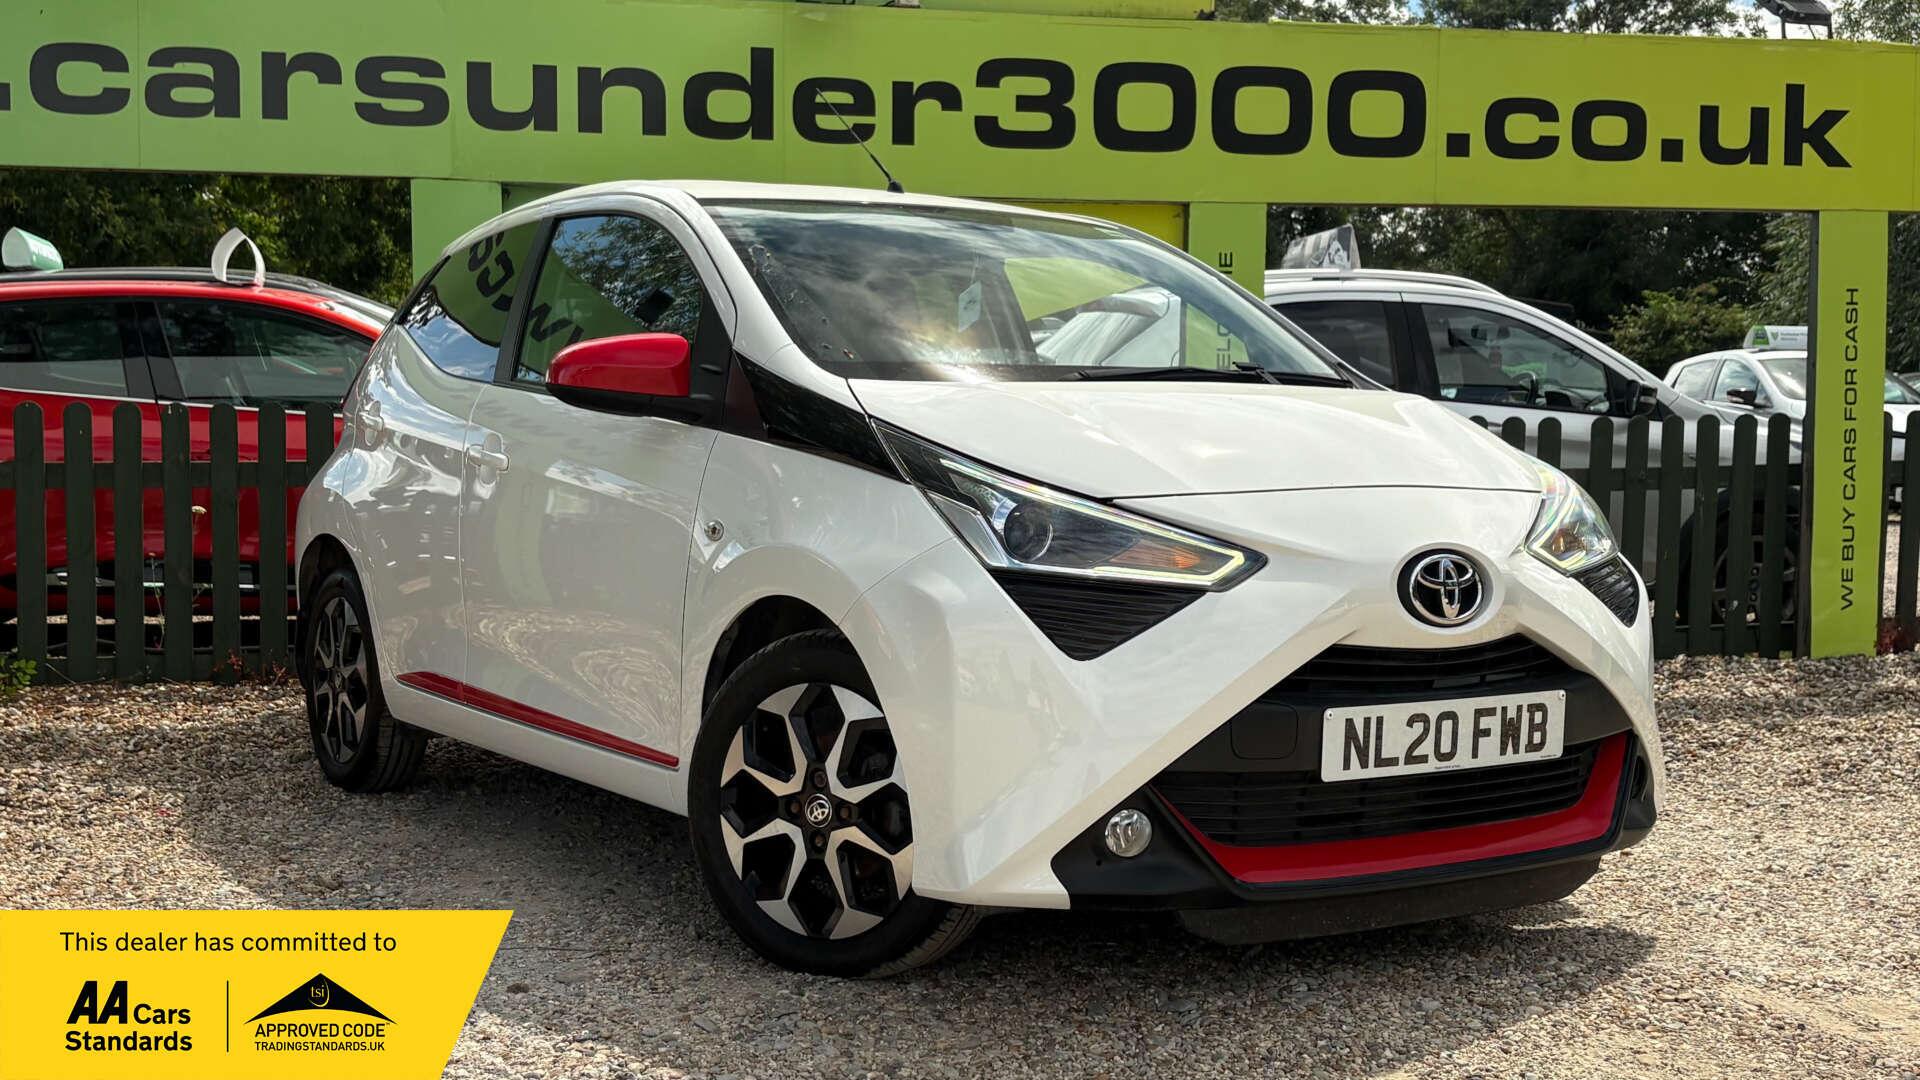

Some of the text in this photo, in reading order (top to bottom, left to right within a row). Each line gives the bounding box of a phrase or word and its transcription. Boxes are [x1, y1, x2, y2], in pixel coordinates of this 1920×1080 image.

[1840, 288, 1859, 611] WE BUY CARS FOR CASH
[1342, 702, 1549, 771] NL20 FWB
